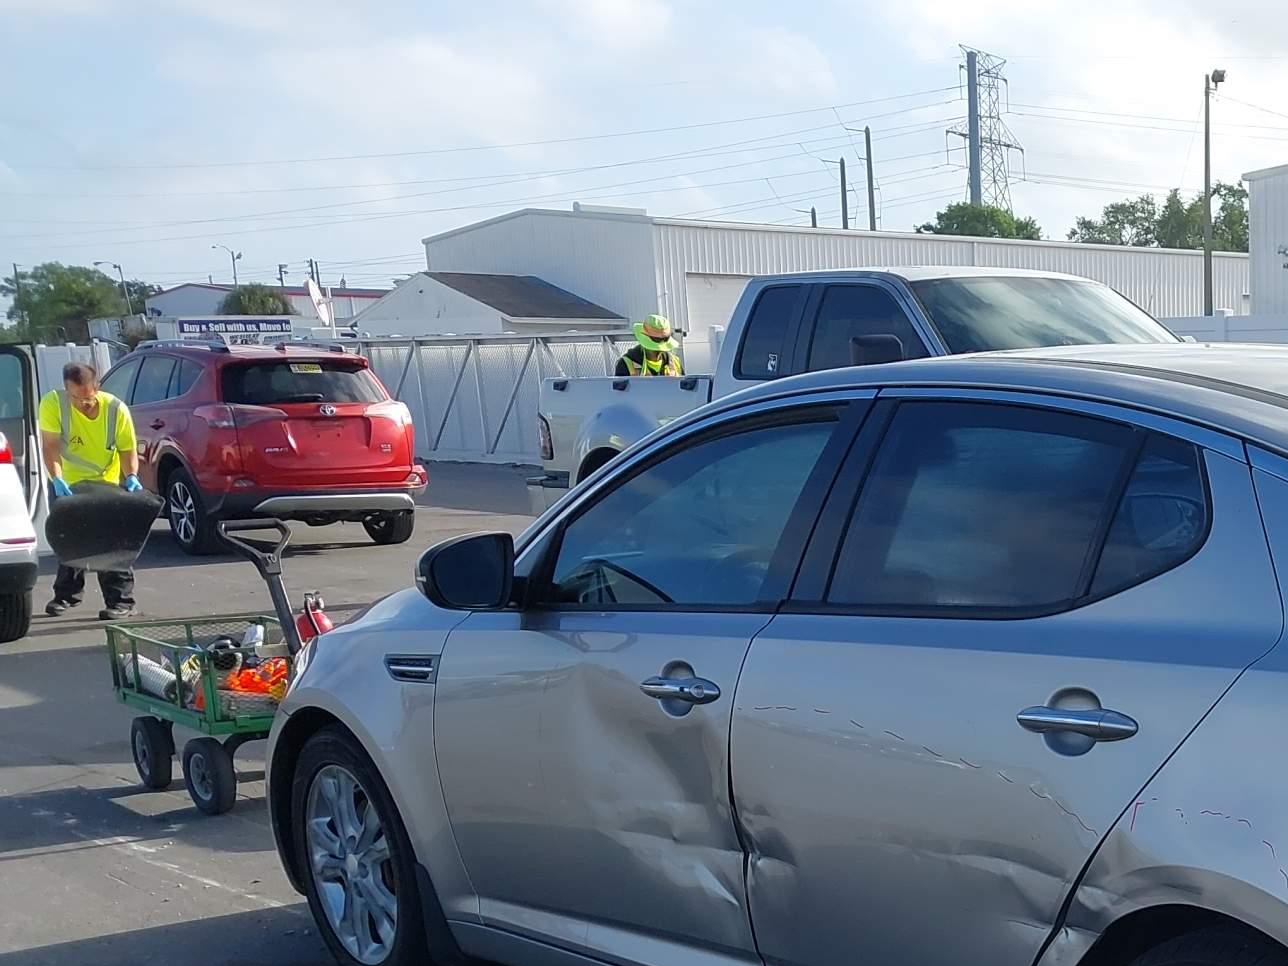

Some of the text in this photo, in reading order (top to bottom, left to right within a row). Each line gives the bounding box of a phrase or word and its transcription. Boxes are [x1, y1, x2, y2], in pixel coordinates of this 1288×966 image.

[183, 323, 200, 332] Buy
[208, 323, 226, 332] Sell
[226, 323, 245, 332] with
[259, 323, 282, 332] Move
